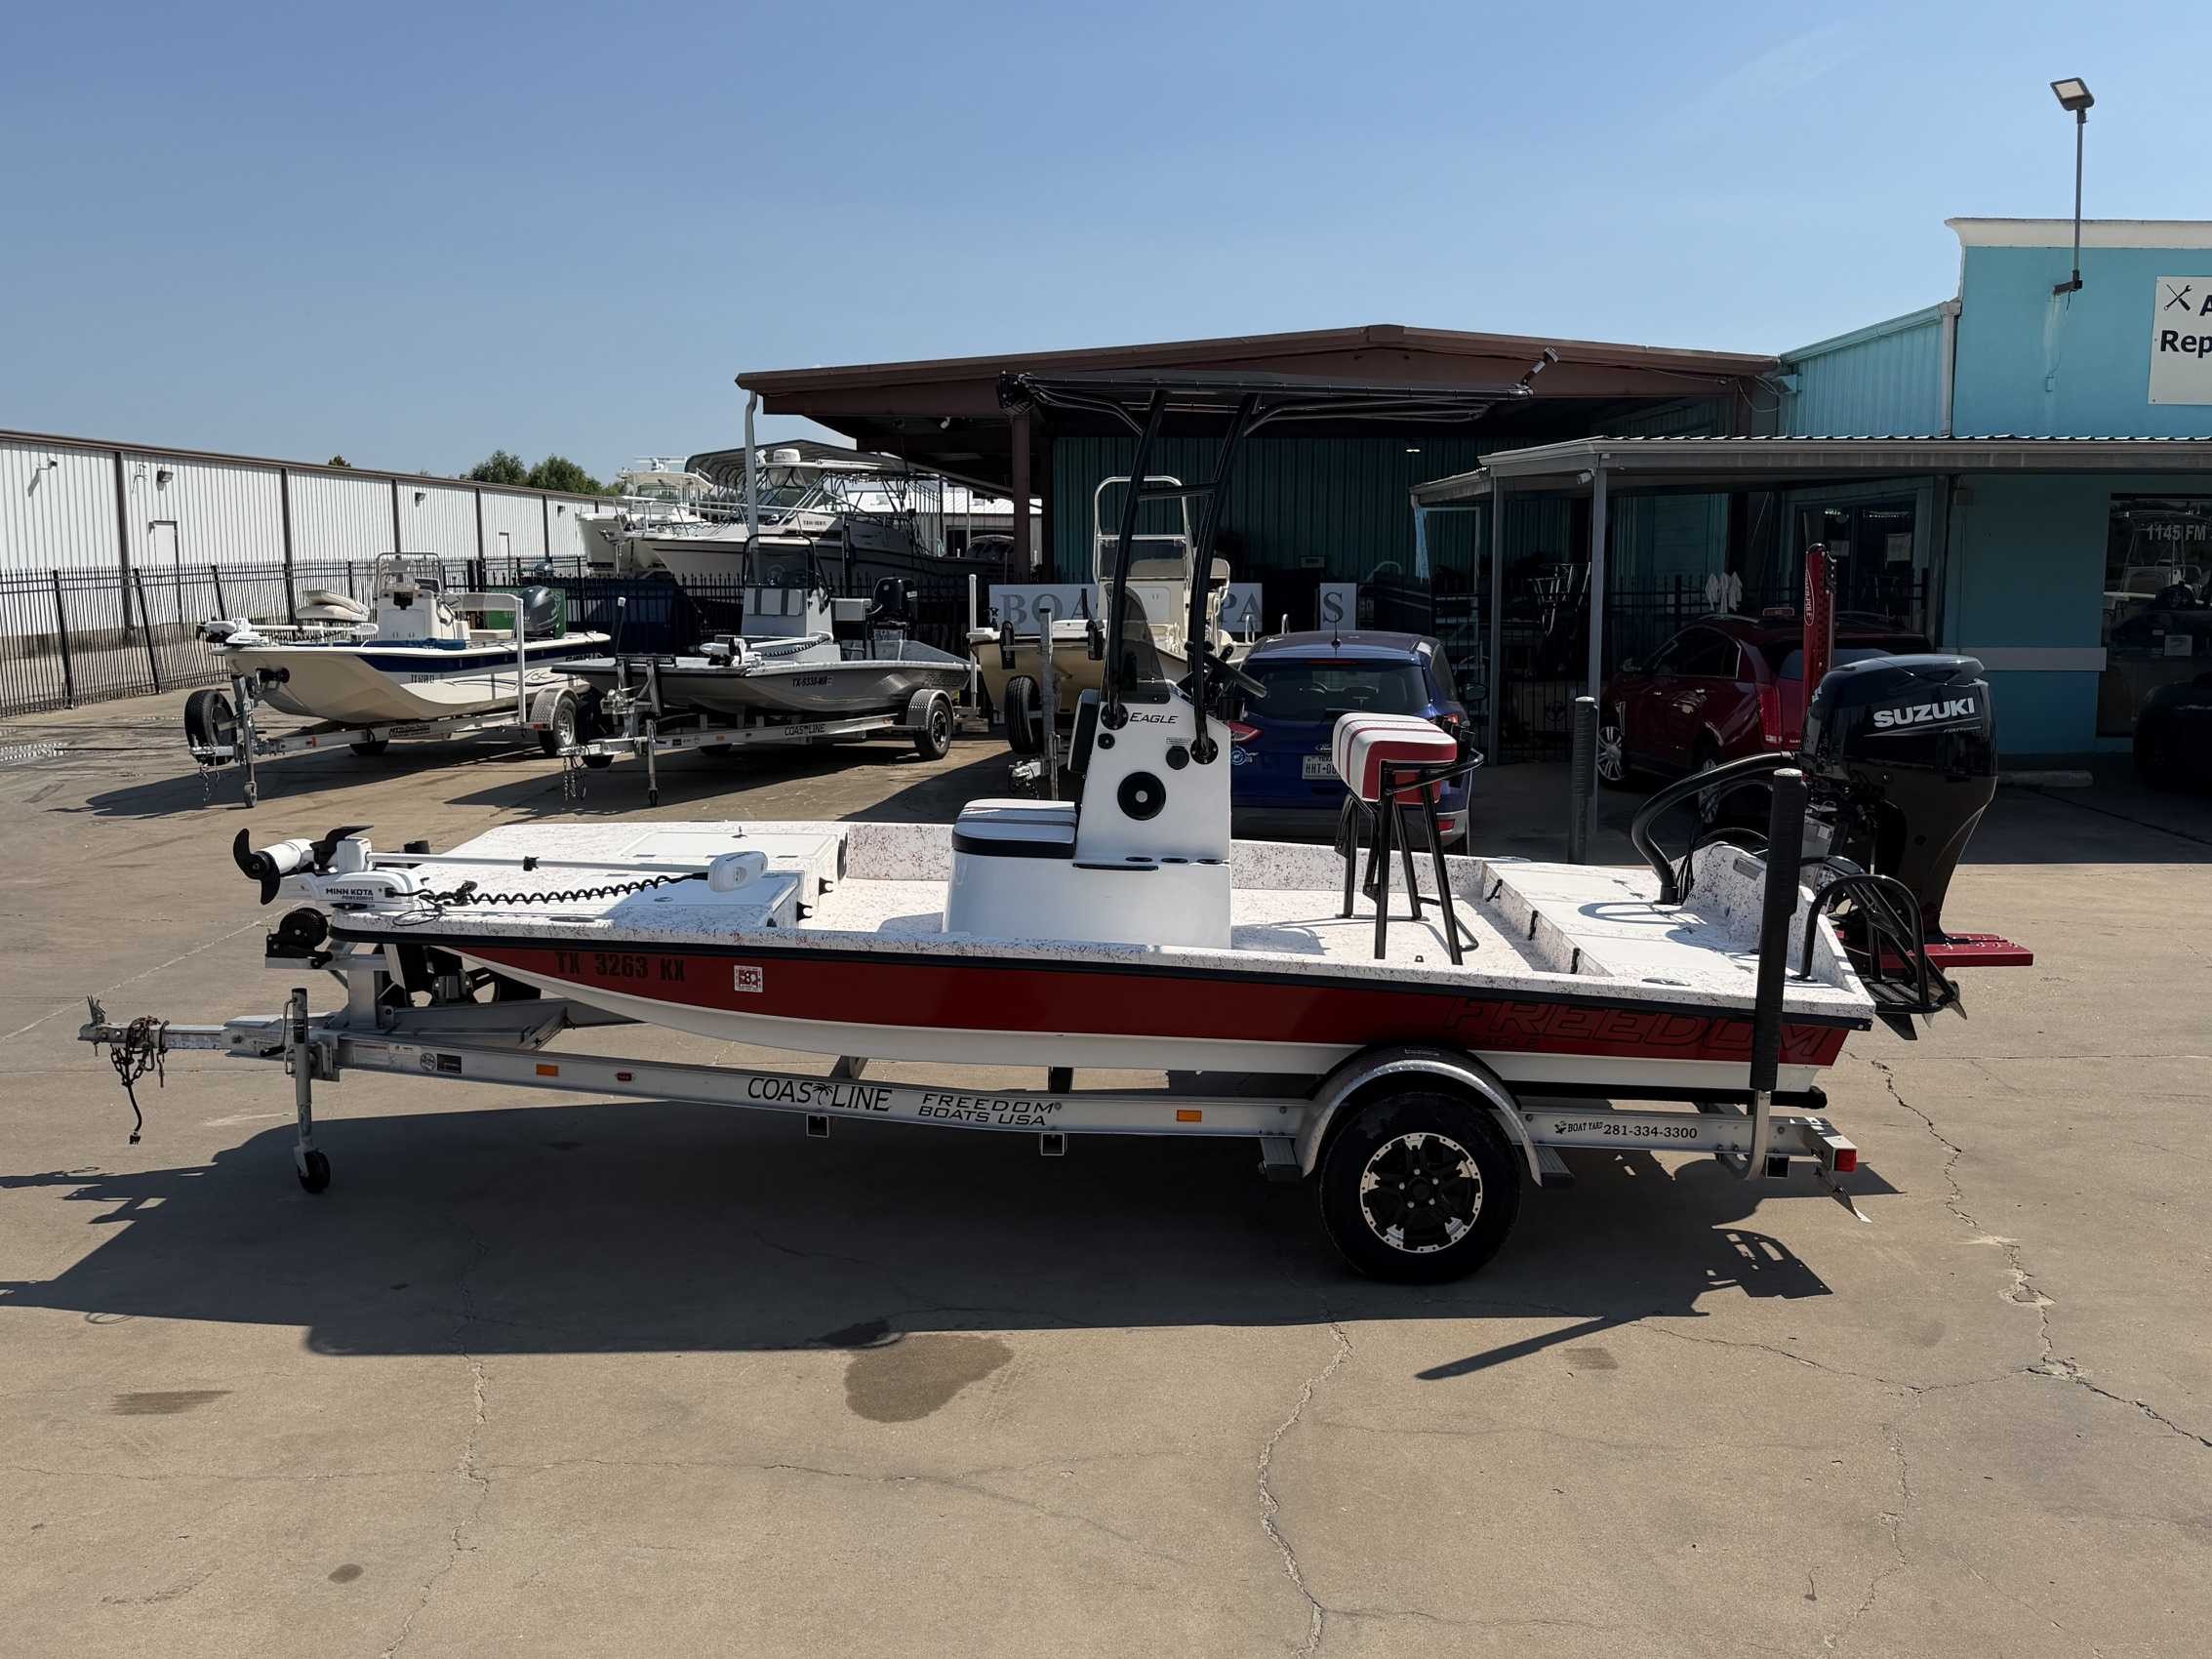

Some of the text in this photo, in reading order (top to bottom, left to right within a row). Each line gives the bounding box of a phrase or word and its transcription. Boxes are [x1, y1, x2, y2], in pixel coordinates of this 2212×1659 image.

[2148, 524, 2206, 541] 1145 FM
[999, 592, 1097, 627] BOA
[1130, 712, 1179, 724] EAGLE
[1873, 697, 1975, 728] SUZUKI
[555, 951, 686, 982] TX 3263 KX
[1442, 996, 1833, 1058] FREEDOM
[922, 1093, 1055, 1114] FREEDOM
[918, 1106, 1047, 1127] BOATS USA
[1568, 1122, 1587, 1132] BOAT
[1603, 1124, 1698, 1139] 281-334-3300
